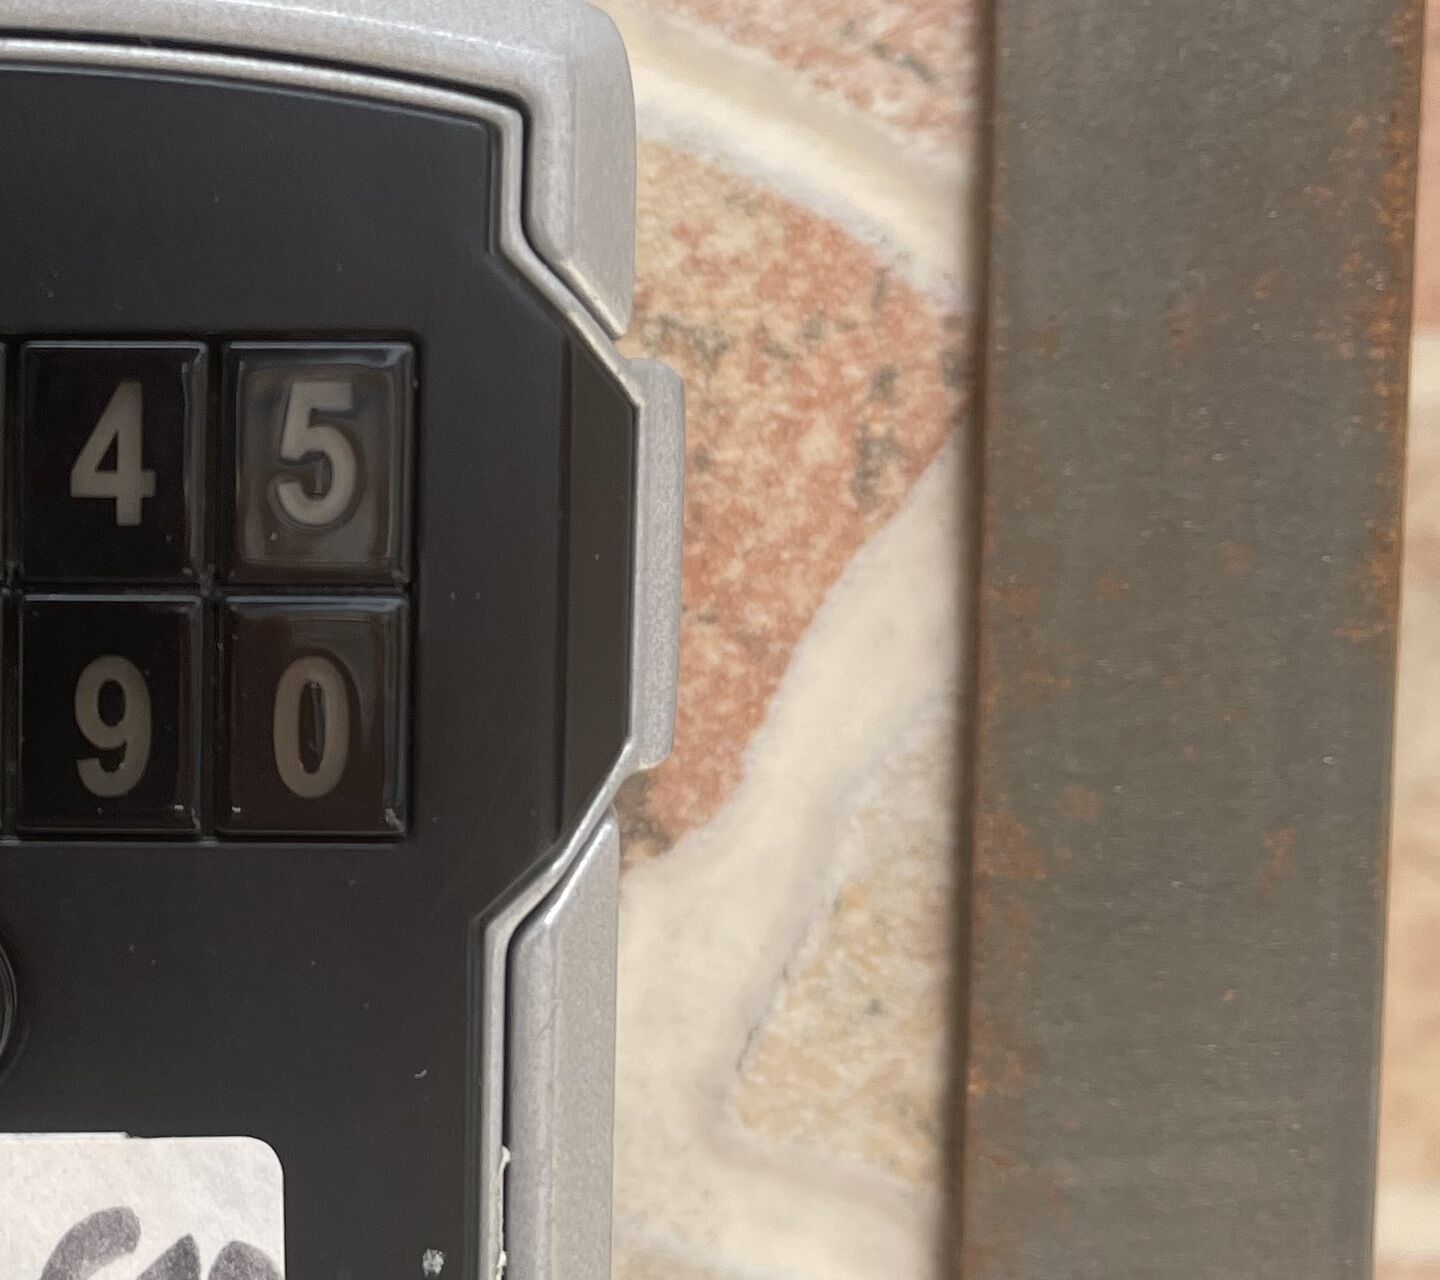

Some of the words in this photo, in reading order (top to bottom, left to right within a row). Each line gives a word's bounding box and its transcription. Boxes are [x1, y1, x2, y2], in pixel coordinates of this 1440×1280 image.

[70, 380, 155, 525] 4
[275, 380, 358, 525] 5
[74, 655, 152, 798] 9
[272, 656, 351, 799] 0
